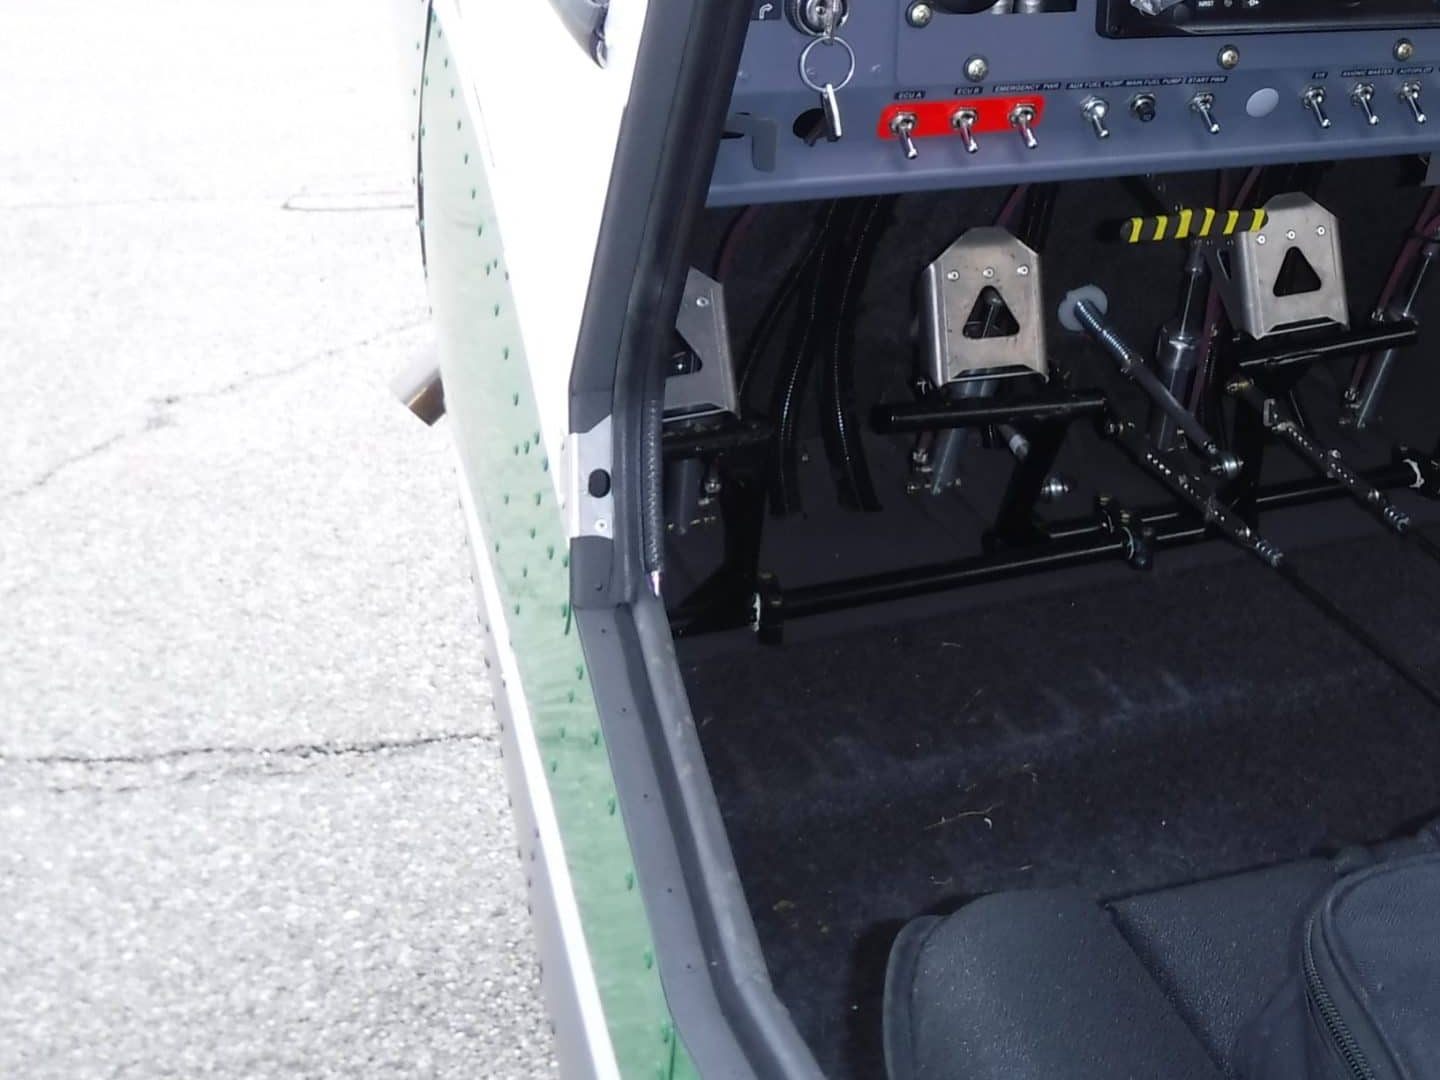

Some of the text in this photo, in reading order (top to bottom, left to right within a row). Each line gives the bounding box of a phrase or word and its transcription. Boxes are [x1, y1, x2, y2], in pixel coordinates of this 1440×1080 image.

[1068, 80, 1123, 90] AUX FUEL PUMP
[1125, 80, 1144, 88] MAIN
[1145, 79, 1161, 87] FUEL
[994, 85, 1041, 93] EMERGENCY
[915, 91, 922, 99] A
